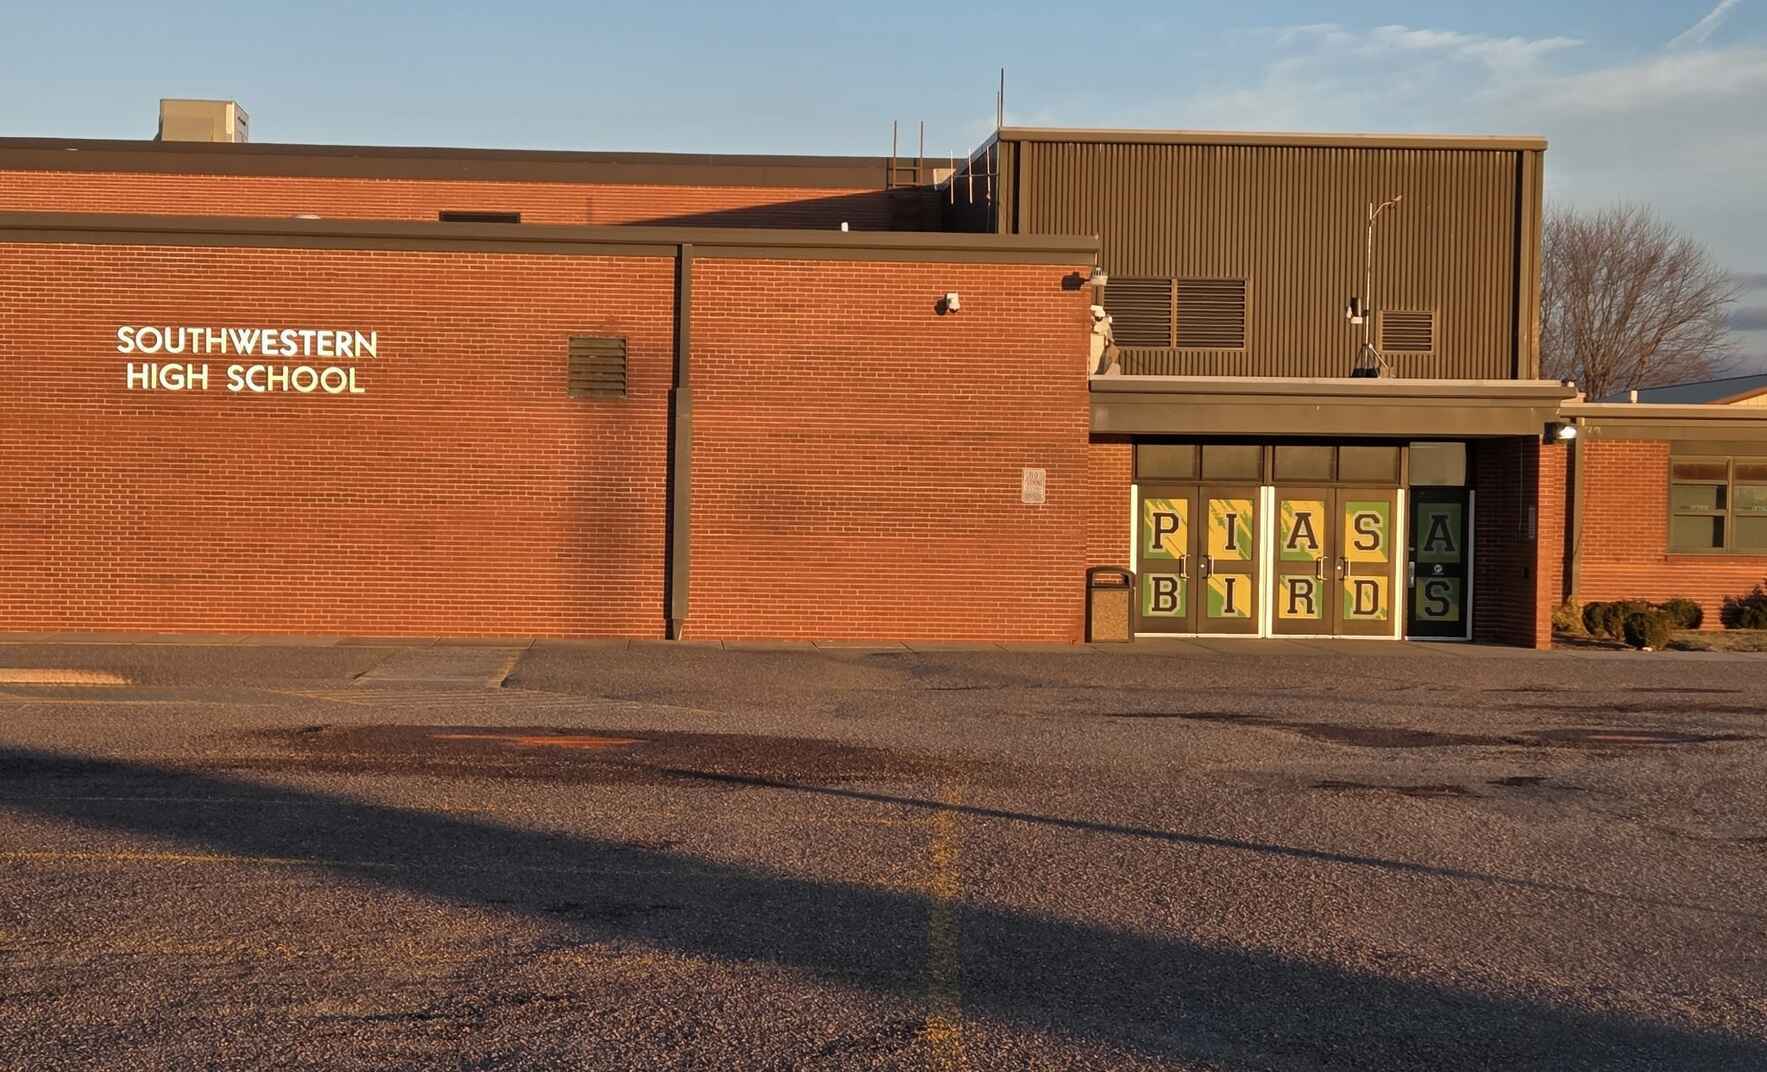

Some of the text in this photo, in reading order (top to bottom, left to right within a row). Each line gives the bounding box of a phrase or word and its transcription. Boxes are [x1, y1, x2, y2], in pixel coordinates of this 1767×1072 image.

[117, 326, 378, 359] SOUTHWESTERN
[127, 363, 366, 394] HIGH SCHOOL
